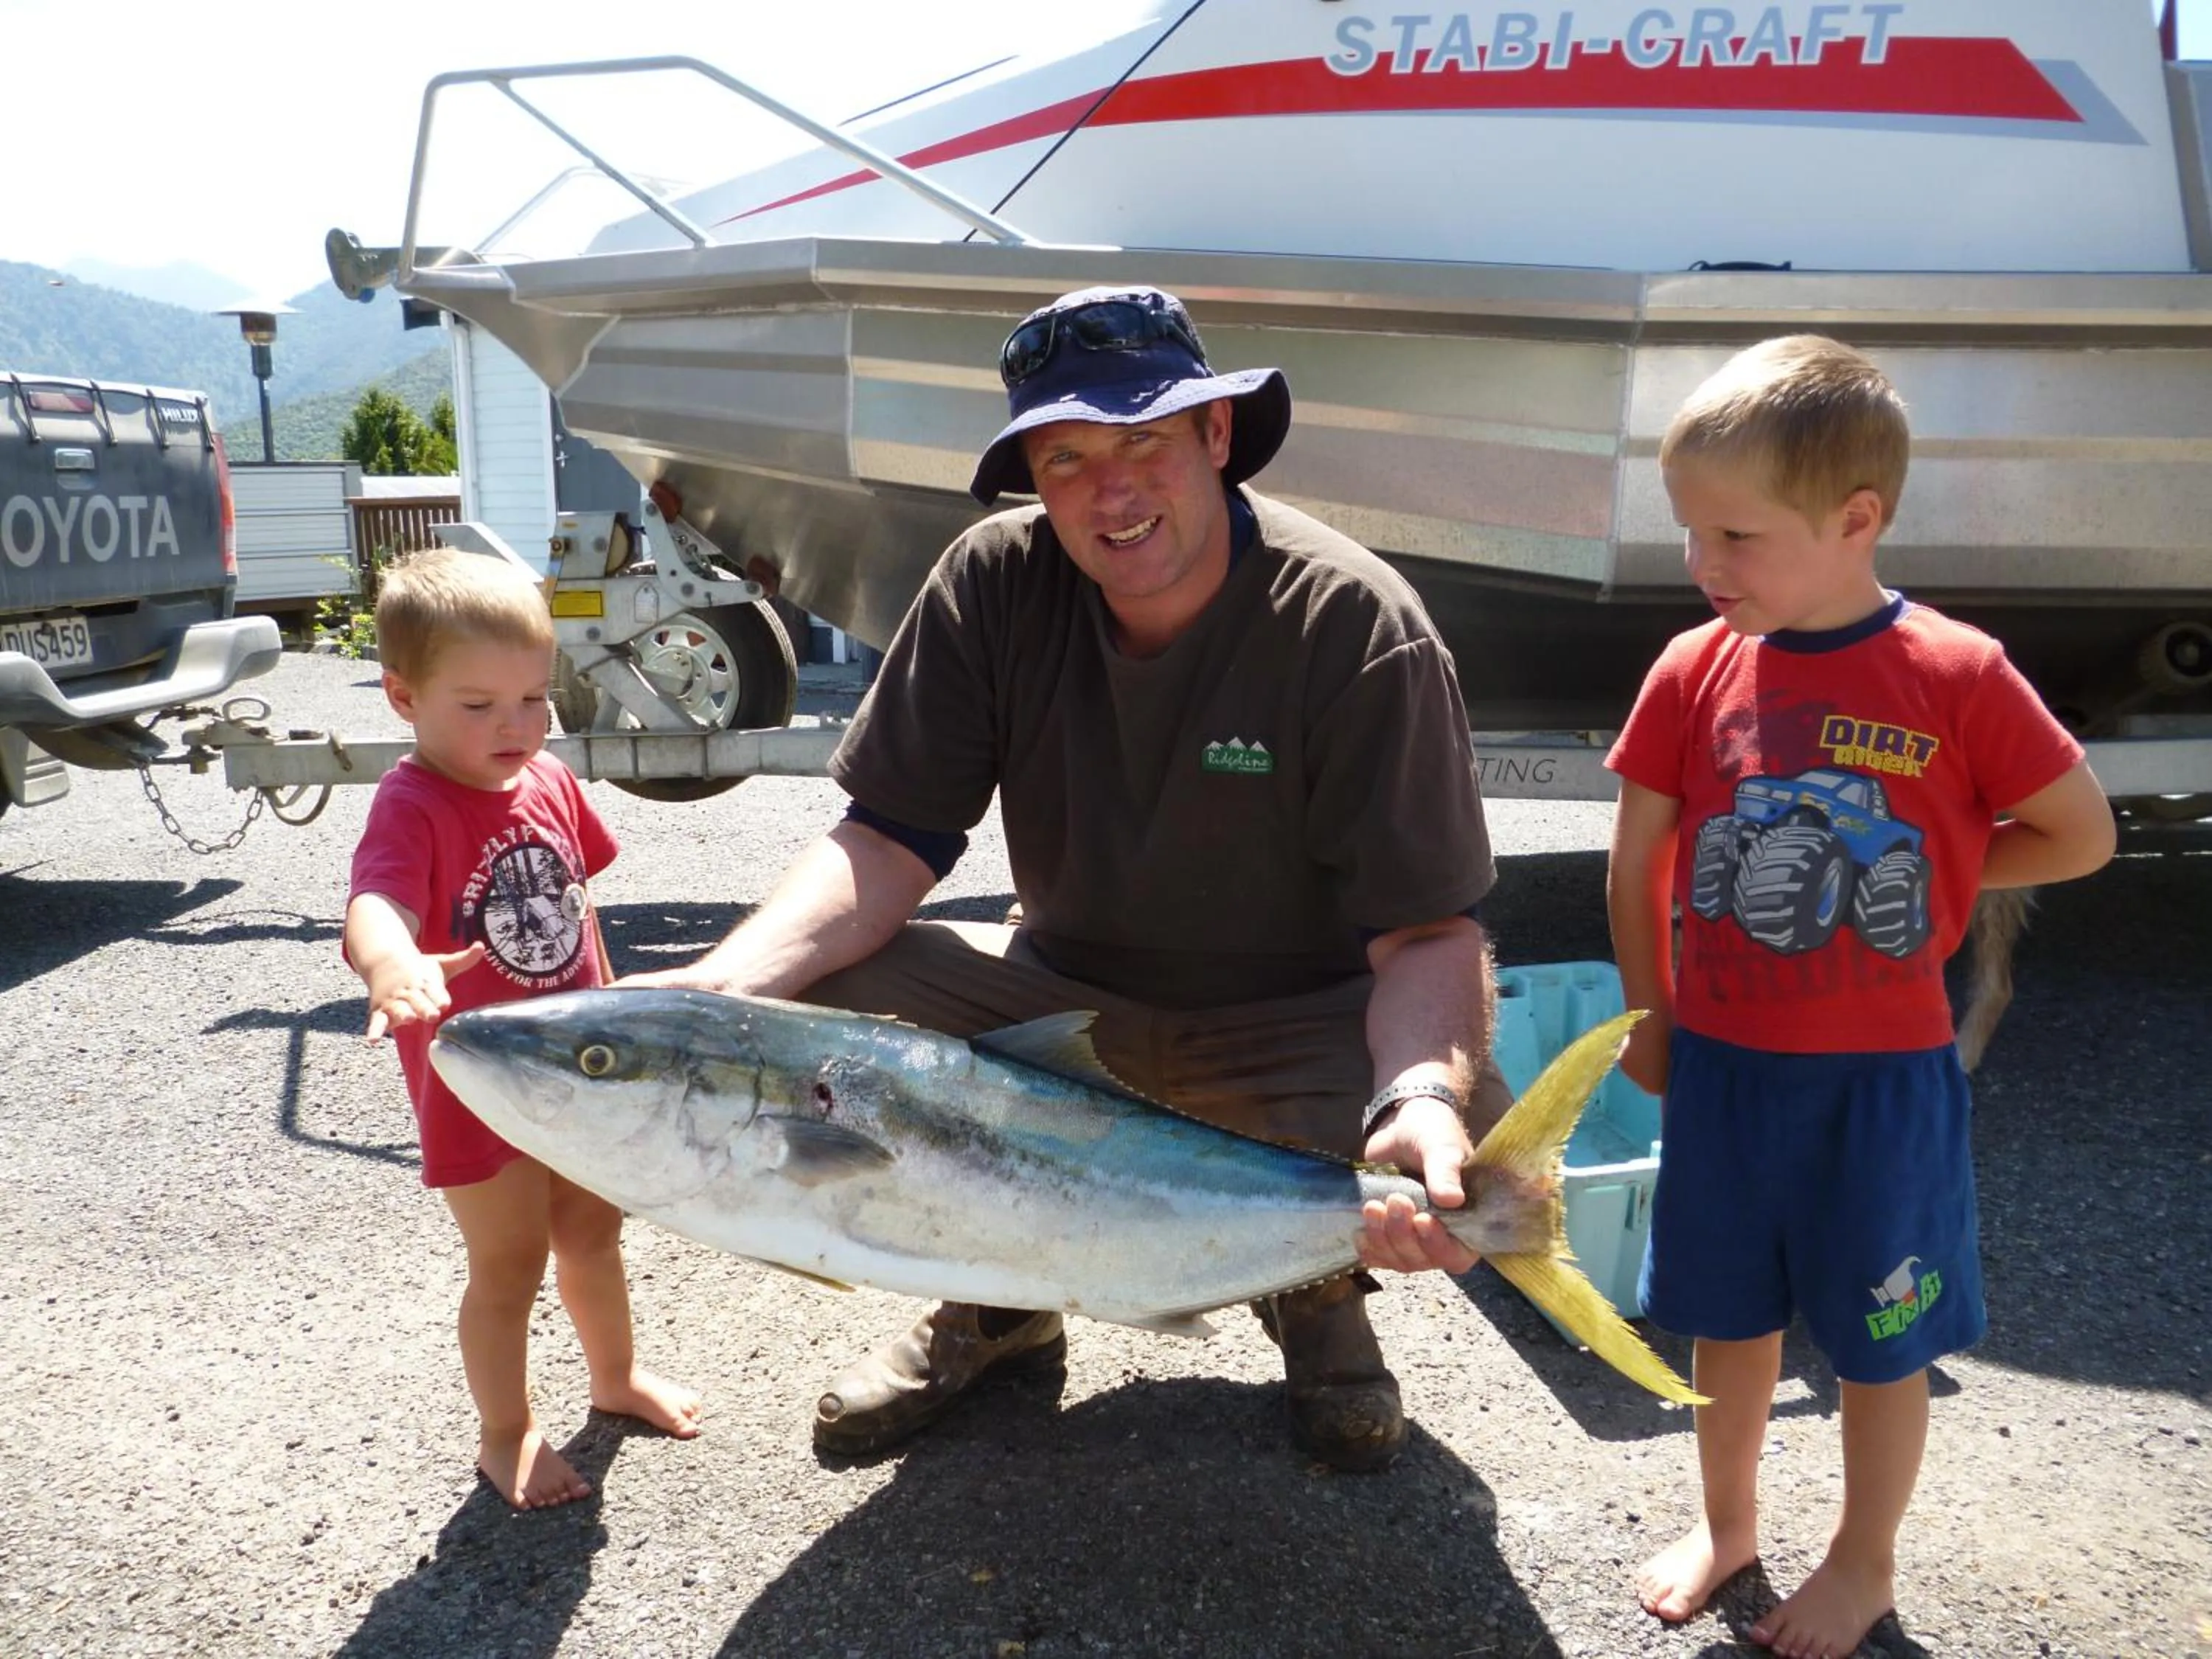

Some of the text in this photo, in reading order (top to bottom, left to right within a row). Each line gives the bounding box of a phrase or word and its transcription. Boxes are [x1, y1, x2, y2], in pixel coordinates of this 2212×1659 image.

[1324, 4, 1905, 76] STABI-CRAFT
[506, 970, 534, 989] FOR
[536, 975, 559, 989] THE
